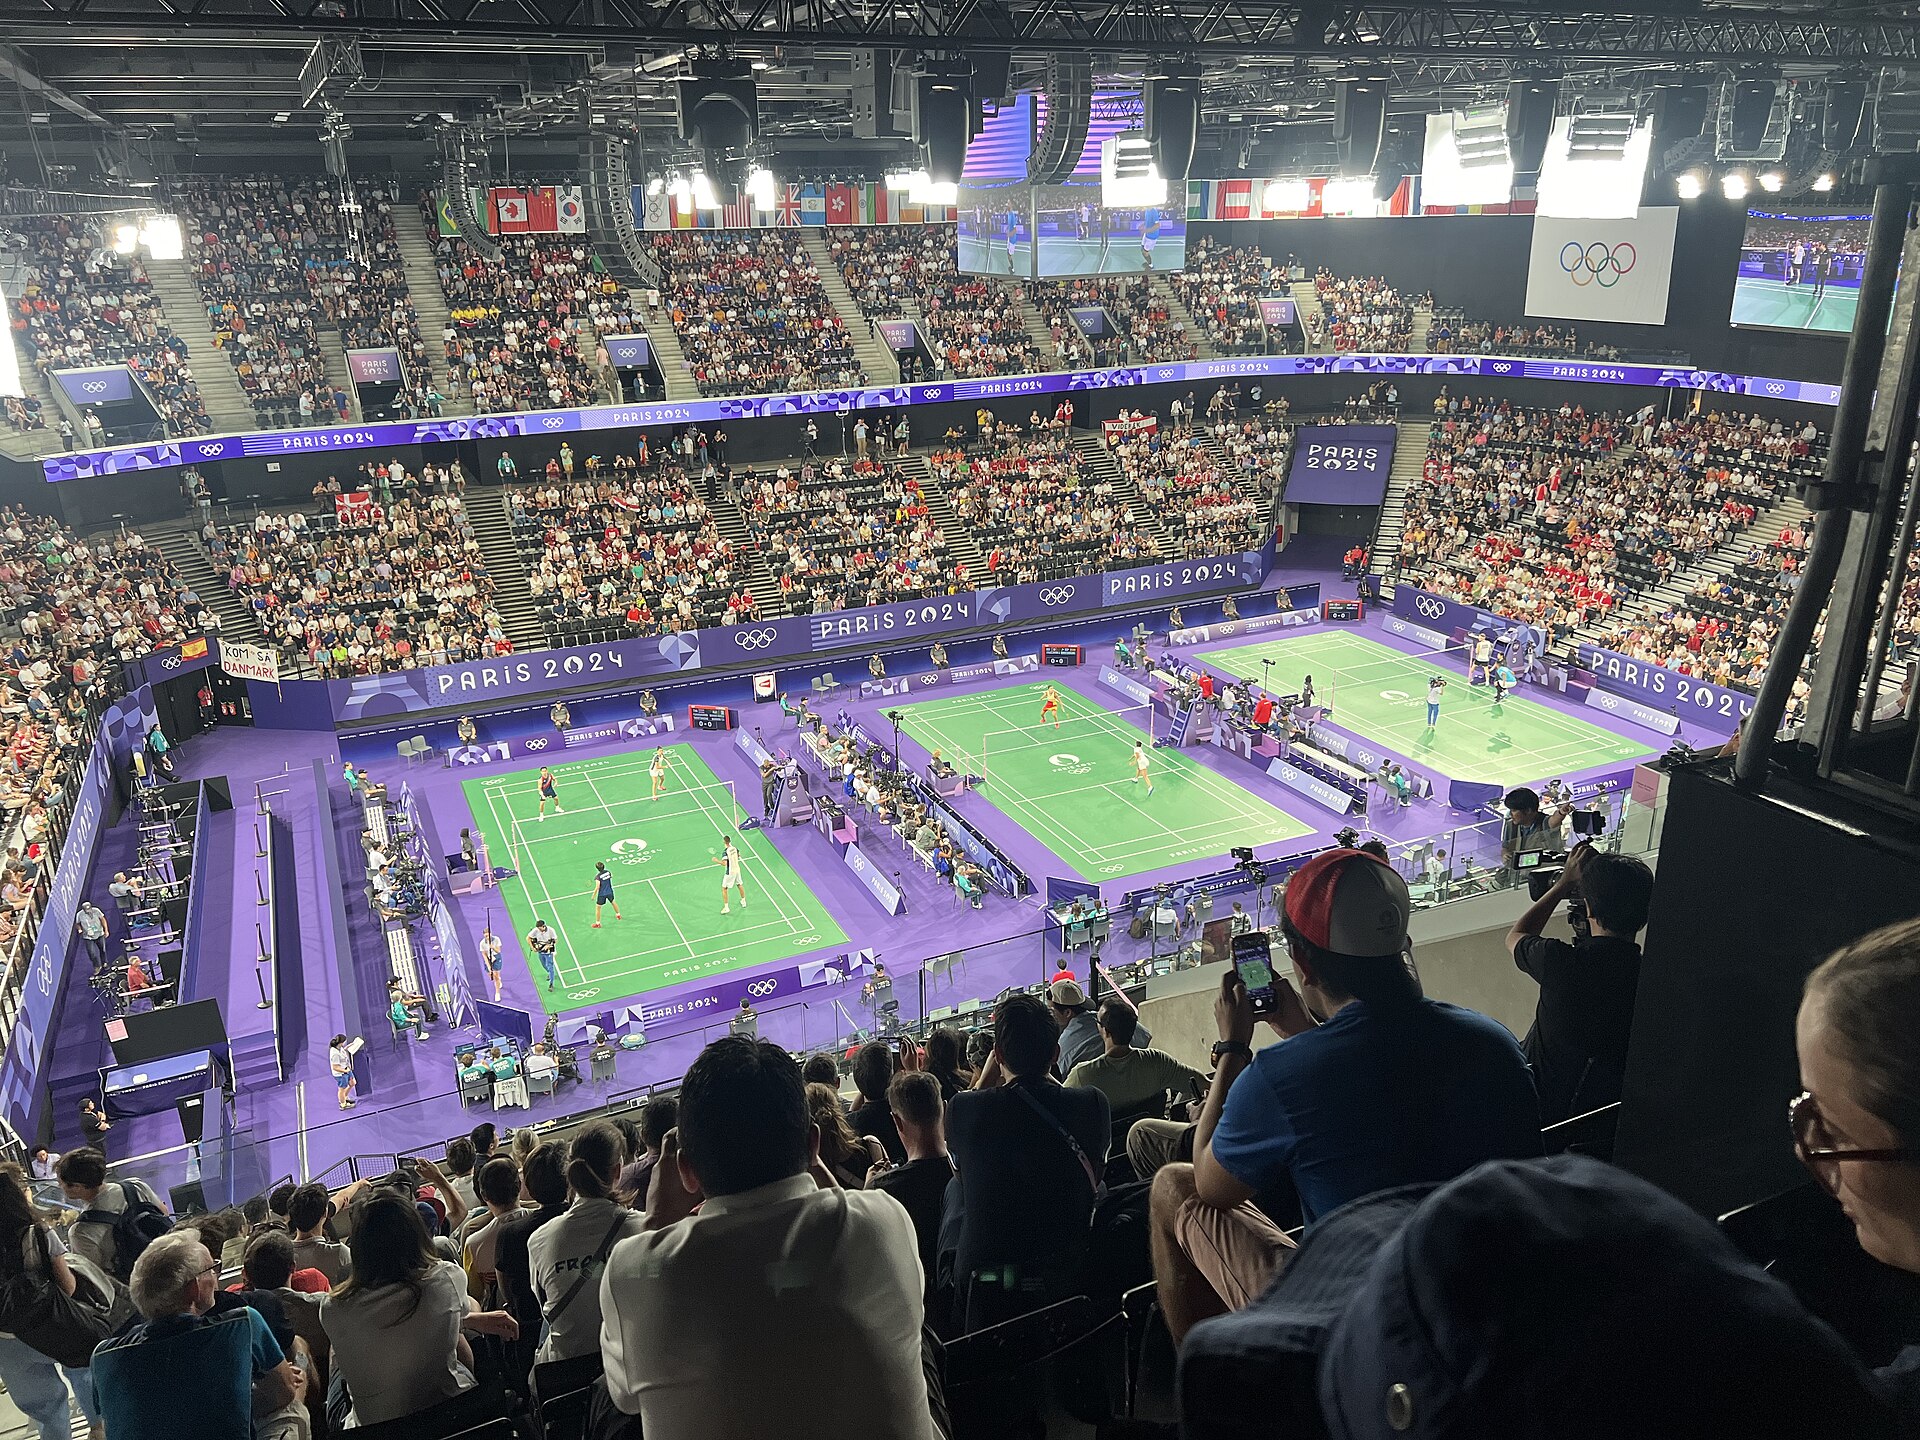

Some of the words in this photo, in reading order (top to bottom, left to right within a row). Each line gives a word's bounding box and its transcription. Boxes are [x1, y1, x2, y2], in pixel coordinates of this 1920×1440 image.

[364, 368, 388, 376] 2024
[1208, 364, 1236, 374] PARIS
[1240, 362, 1268, 372] 2024
[1553, 367, 1588, 378] PARIS
[1592, 369, 1624, 380] 2024
[980, 384, 1012, 394] PARIS
[1014, 380, 1042, 392] 2024
[614, 412, 652, 422] PARIS
[656, 408, 690, 420] 2024
[283, 436, 328, 448] PARIS
[333, 432, 374, 445] 2024
[1306, 458, 1376, 472] 2024
[1182, 562, 1236, 584] 2024
[904, 602, 968, 626] 2024
[225, 646, 248, 658] KOM
[224, 661, 274, 679] DANMARK
[543, 650, 622, 679] 2024
[569, 732, 593, 742] PARIS
[594, 728, 616, 738] 2024
[1598, 780, 1618, 788] 024
[664, 964, 700, 978] PARIS
[704, 956, 737, 968] 2024
[650, 1005, 684, 1020] PARIS
[687, 996, 718, 1010] 2024
